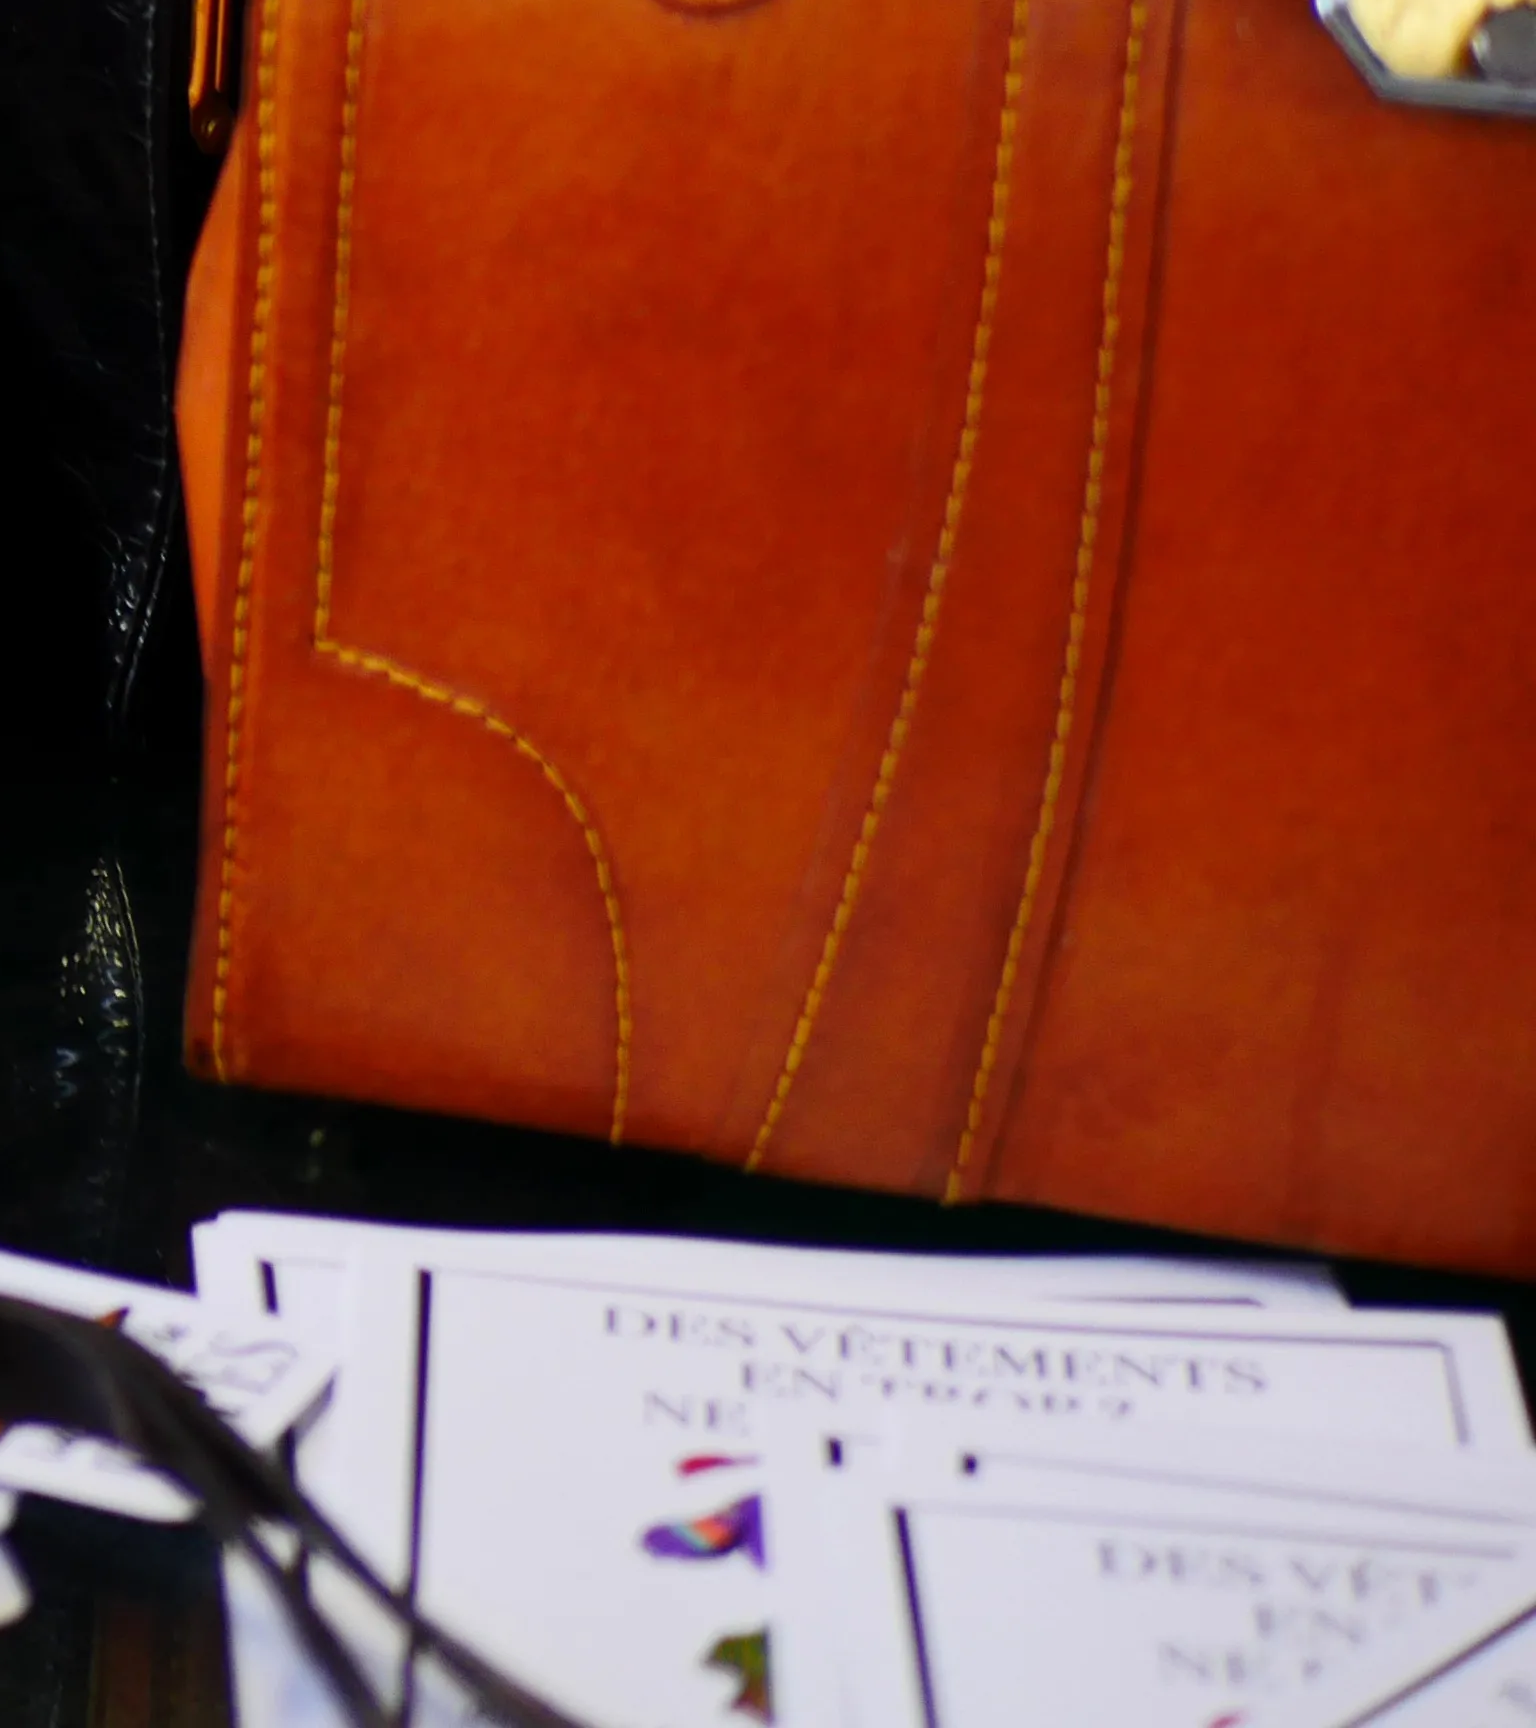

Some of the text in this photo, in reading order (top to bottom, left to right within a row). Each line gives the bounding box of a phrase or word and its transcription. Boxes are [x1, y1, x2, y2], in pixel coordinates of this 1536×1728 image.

[601, 1303, 1266, 1394] DES VÊTEMENTS
[739, 1360, 840, 1402] EN
[1096, 1540, 1266, 1589] DES
